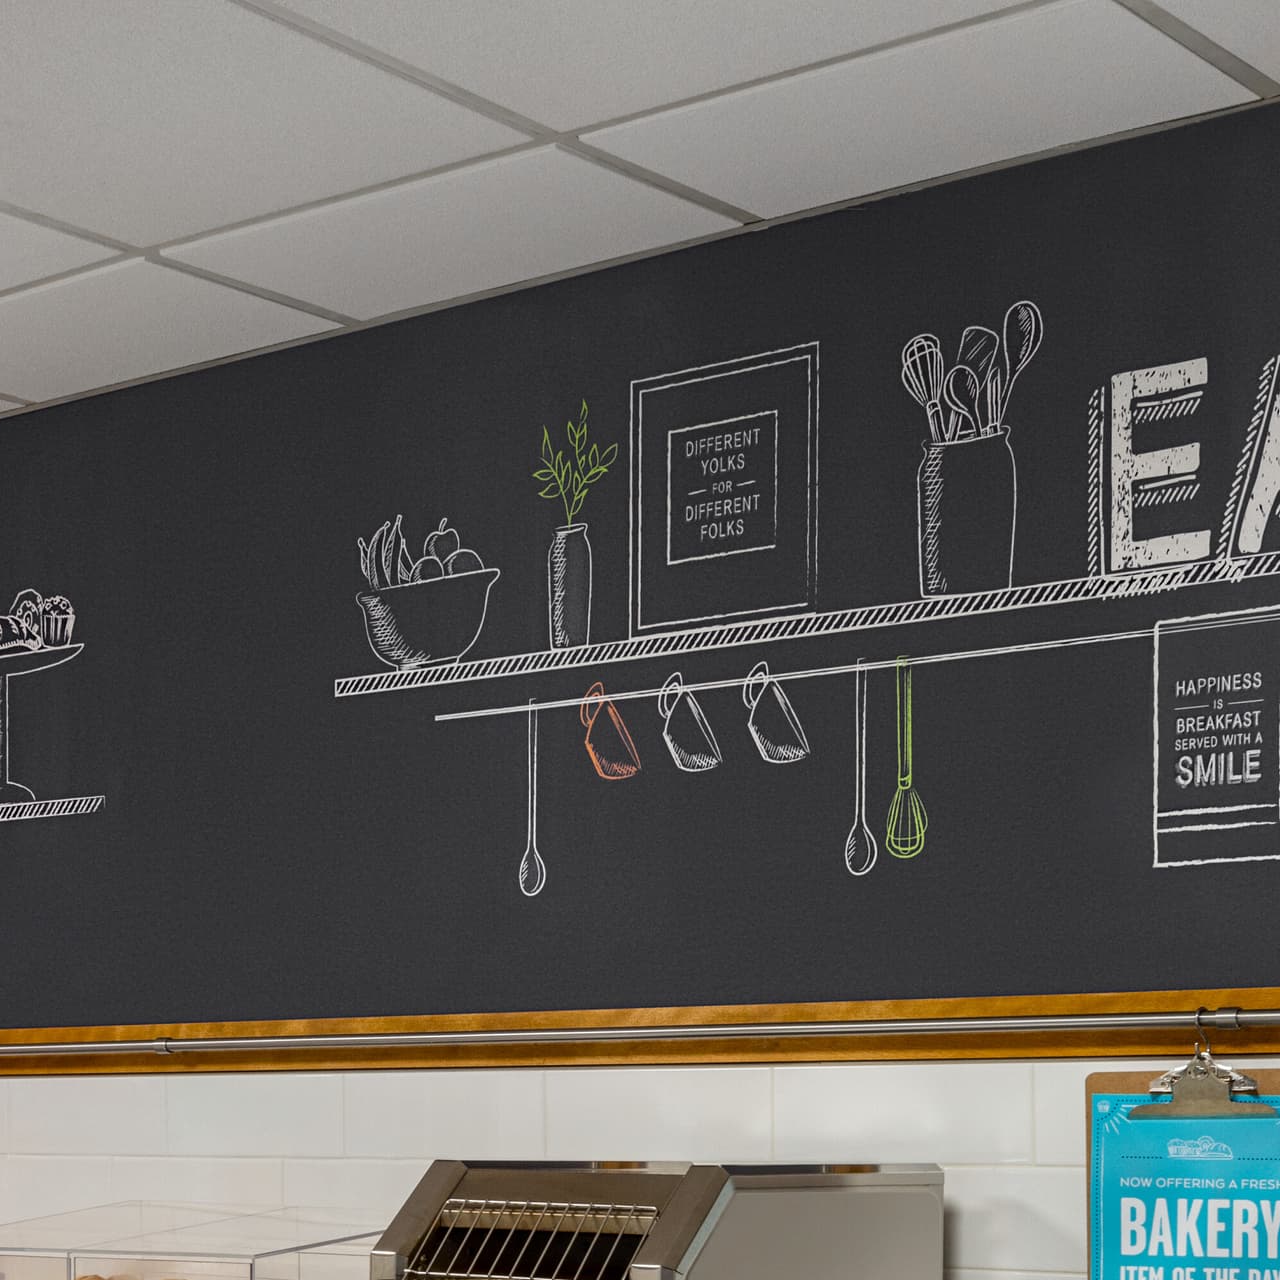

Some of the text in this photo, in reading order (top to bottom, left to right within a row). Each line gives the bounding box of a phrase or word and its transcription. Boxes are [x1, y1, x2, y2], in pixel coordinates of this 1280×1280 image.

[686, 428, 761, 457] DIFFERENT
[701, 453, 745, 476] YOLKS
[712, 481, 733, 495] FOR
[686, 494, 761, 521] DIFFERENT
[700, 519, 744, 542] FOLKS
[1176, 672, 1262, 697] HAPPINESS
[1213, 699, 1224, 710] IS
[1177, 711, 1261, 734] BREAKFAST
[1175, 731, 1263, 751] SERVED WITH A
[1175, 749, 1262, 788] SMILE
[1120, 1177, 1152, 1188] NOW
[1155, 1177, 1225, 1189] OFFERING
[1228, 1179, 1238, 1189] A
